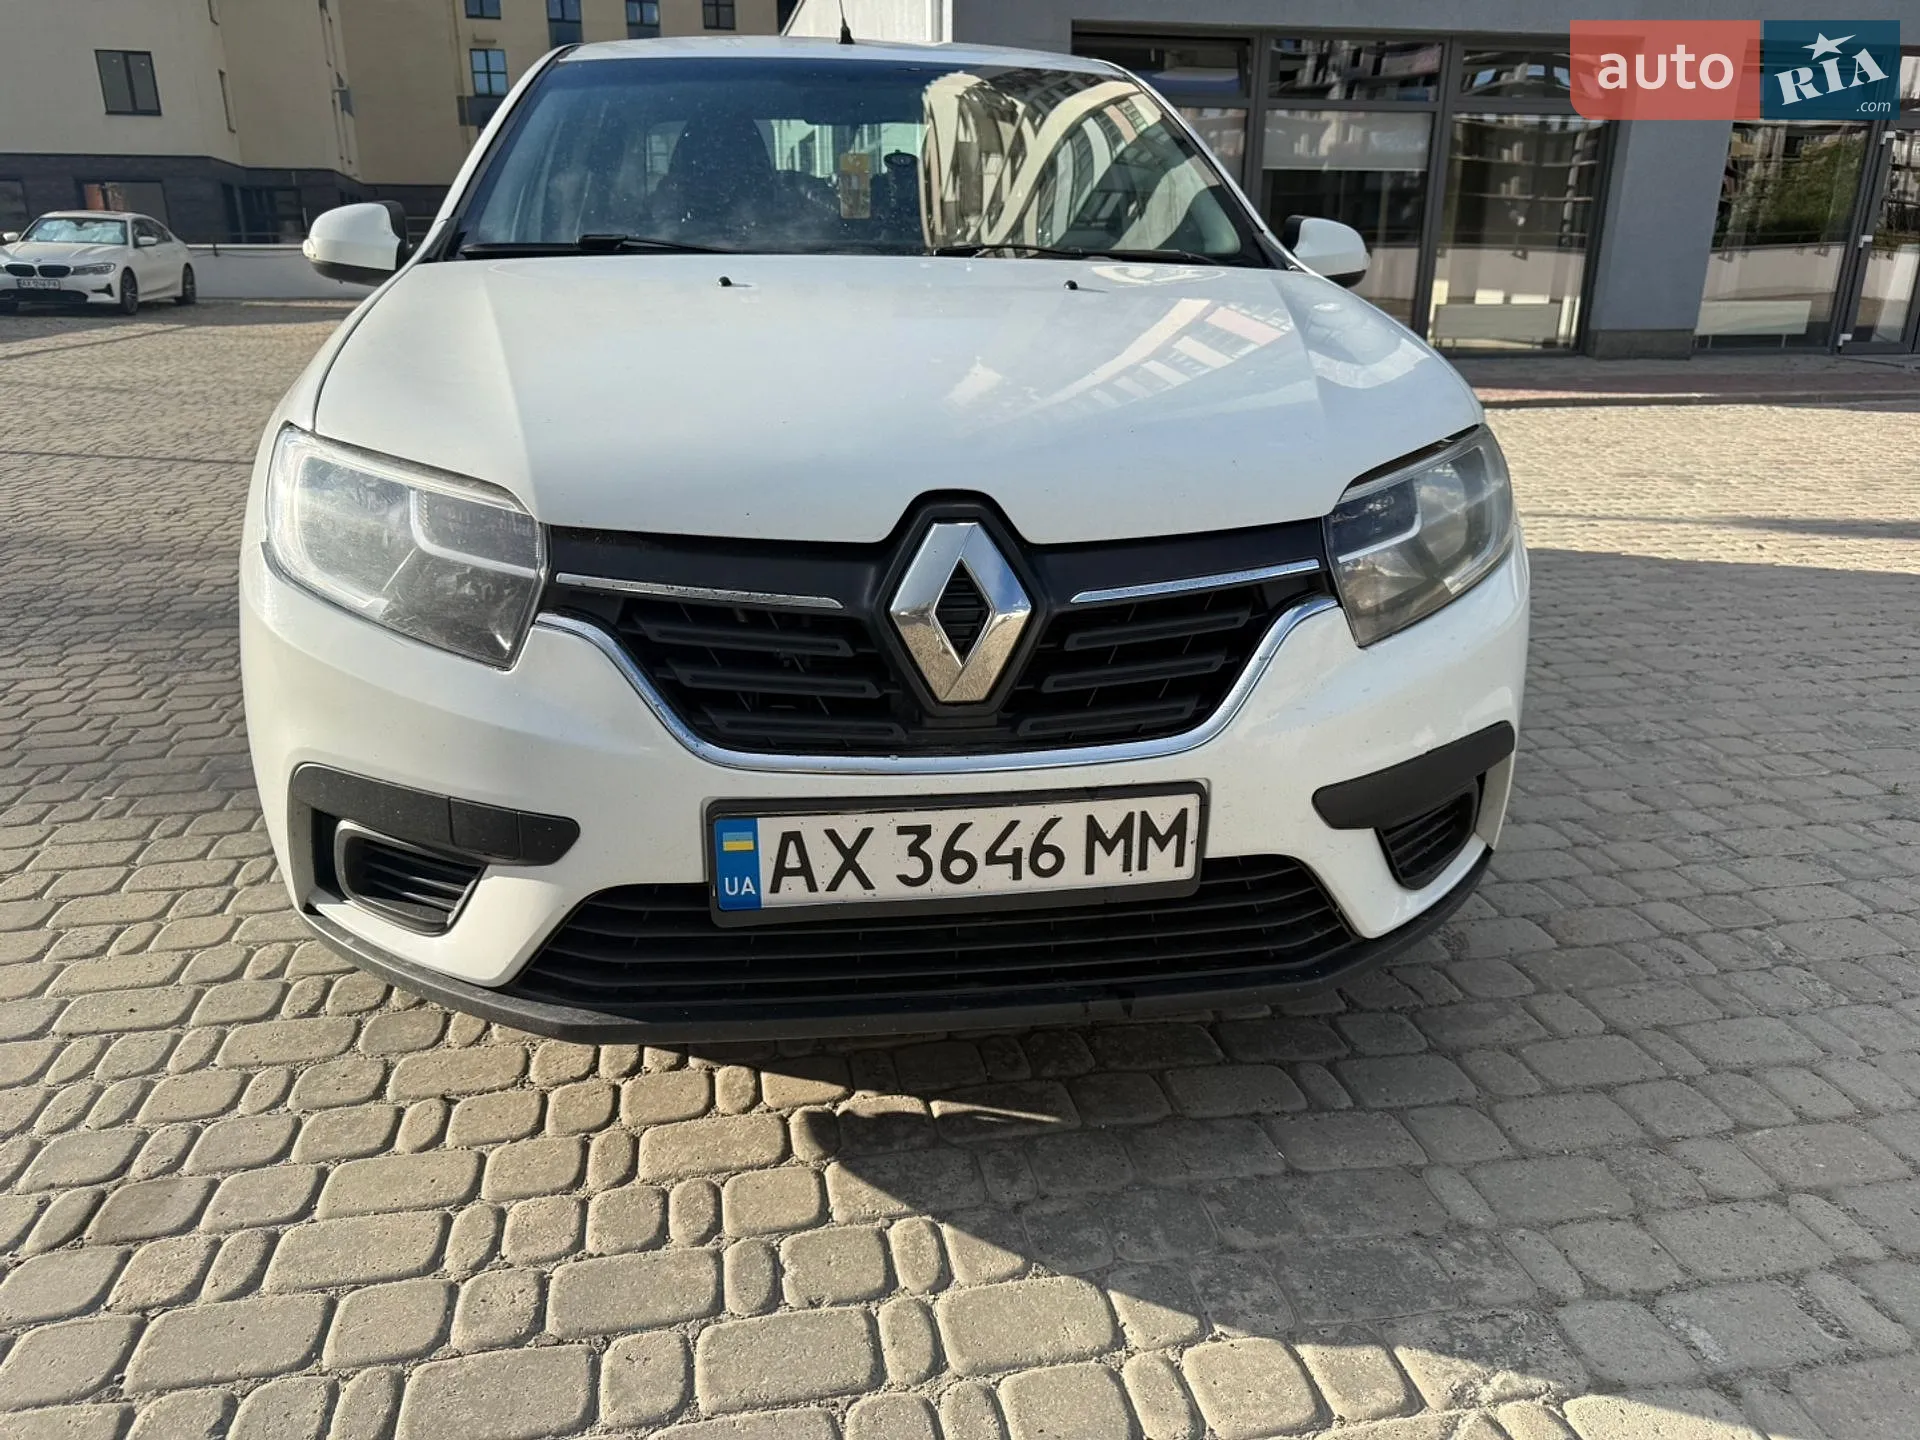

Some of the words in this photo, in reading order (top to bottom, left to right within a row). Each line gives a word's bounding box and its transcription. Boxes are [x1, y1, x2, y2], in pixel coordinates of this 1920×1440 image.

[768, 826, 875, 895] AX
[895, 816, 1066, 888] 3646
[1084, 807, 1188, 876] MM
[724, 877, 756, 897] UA
